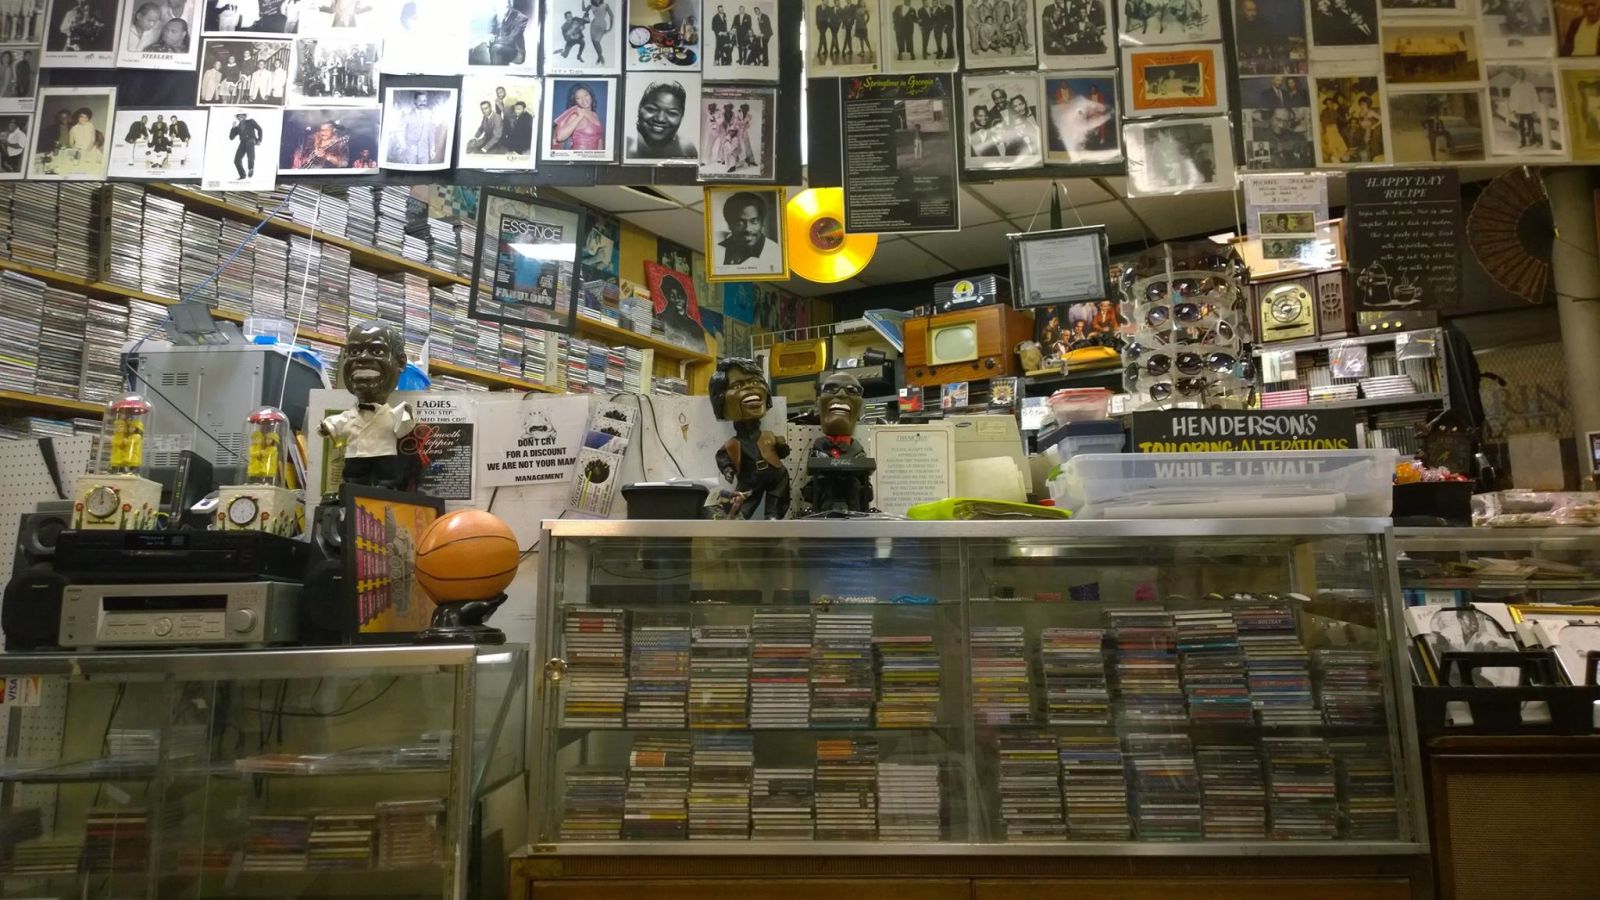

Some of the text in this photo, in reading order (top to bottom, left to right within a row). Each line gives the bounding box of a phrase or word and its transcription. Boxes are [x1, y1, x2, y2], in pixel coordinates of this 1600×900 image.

[864, 76, 899, 90] Springtime
[908, 75, 934, 89] Georgia
[1365, 175, 1445, 188] HAPPY DAY
[1384, 188, 1427, 199] RECIPE
[501, 219, 562, 241] ESSENCE
[1172, 413, 1318, 437] HENDERSON'S
[540, 436, 556, 446] CRY
[506, 447, 566, 459] FOR A DISCOUNT
[487, 462, 500, 471] WE
[502, 462, 517, 470] ARE
[518, 460, 533, 469] NOT
[536, 459, 556, 468] YOUR
[515, 472, 564, 482] MANAGEMENT
[8, 678, 18, 701] VISA
